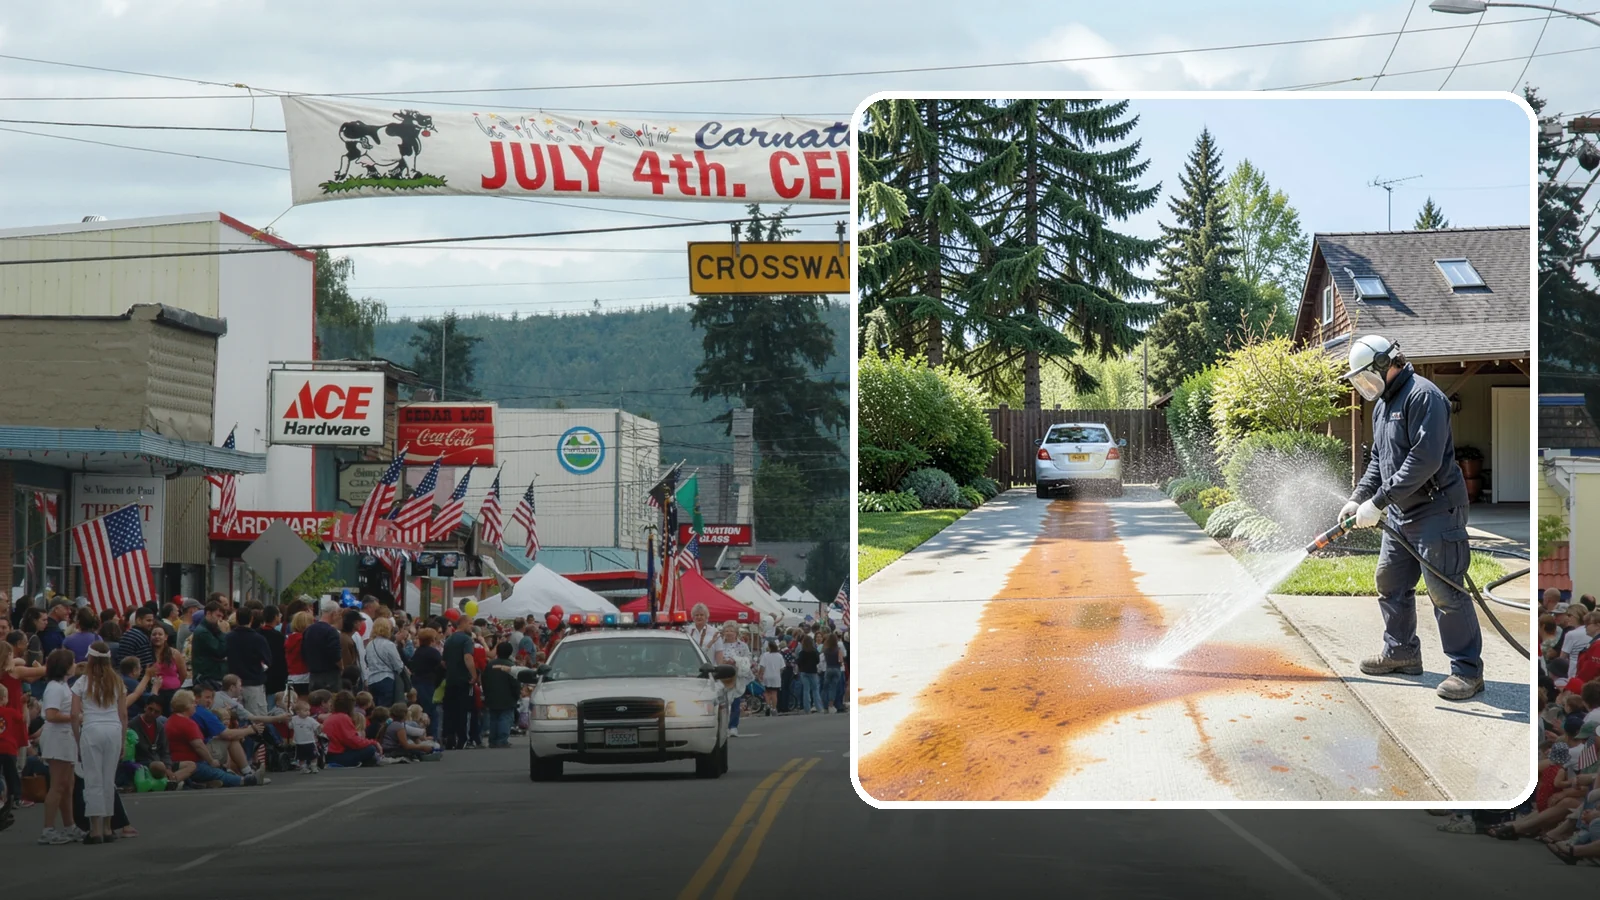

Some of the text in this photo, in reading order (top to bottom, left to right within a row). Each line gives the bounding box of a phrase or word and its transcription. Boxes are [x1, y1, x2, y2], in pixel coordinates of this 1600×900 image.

[481, 141, 605, 192] JULY
[632, 150, 746, 197] 4th.
[697, 254, 850, 280] CROSSWA
[282, 380, 373, 420] ACE
[405, 409, 452, 421] CEDAR
[283, 421, 370, 436] Hardware
[416, 428, 477, 447] Coca-Cola
[95, 485, 124, 495] Vincent
[126, 485, 136, 494] de
[137, 486, 155, 495] Paul
[688, 526, 742, 535] CRNATION
[699, 535, 730, 543] GLASS
